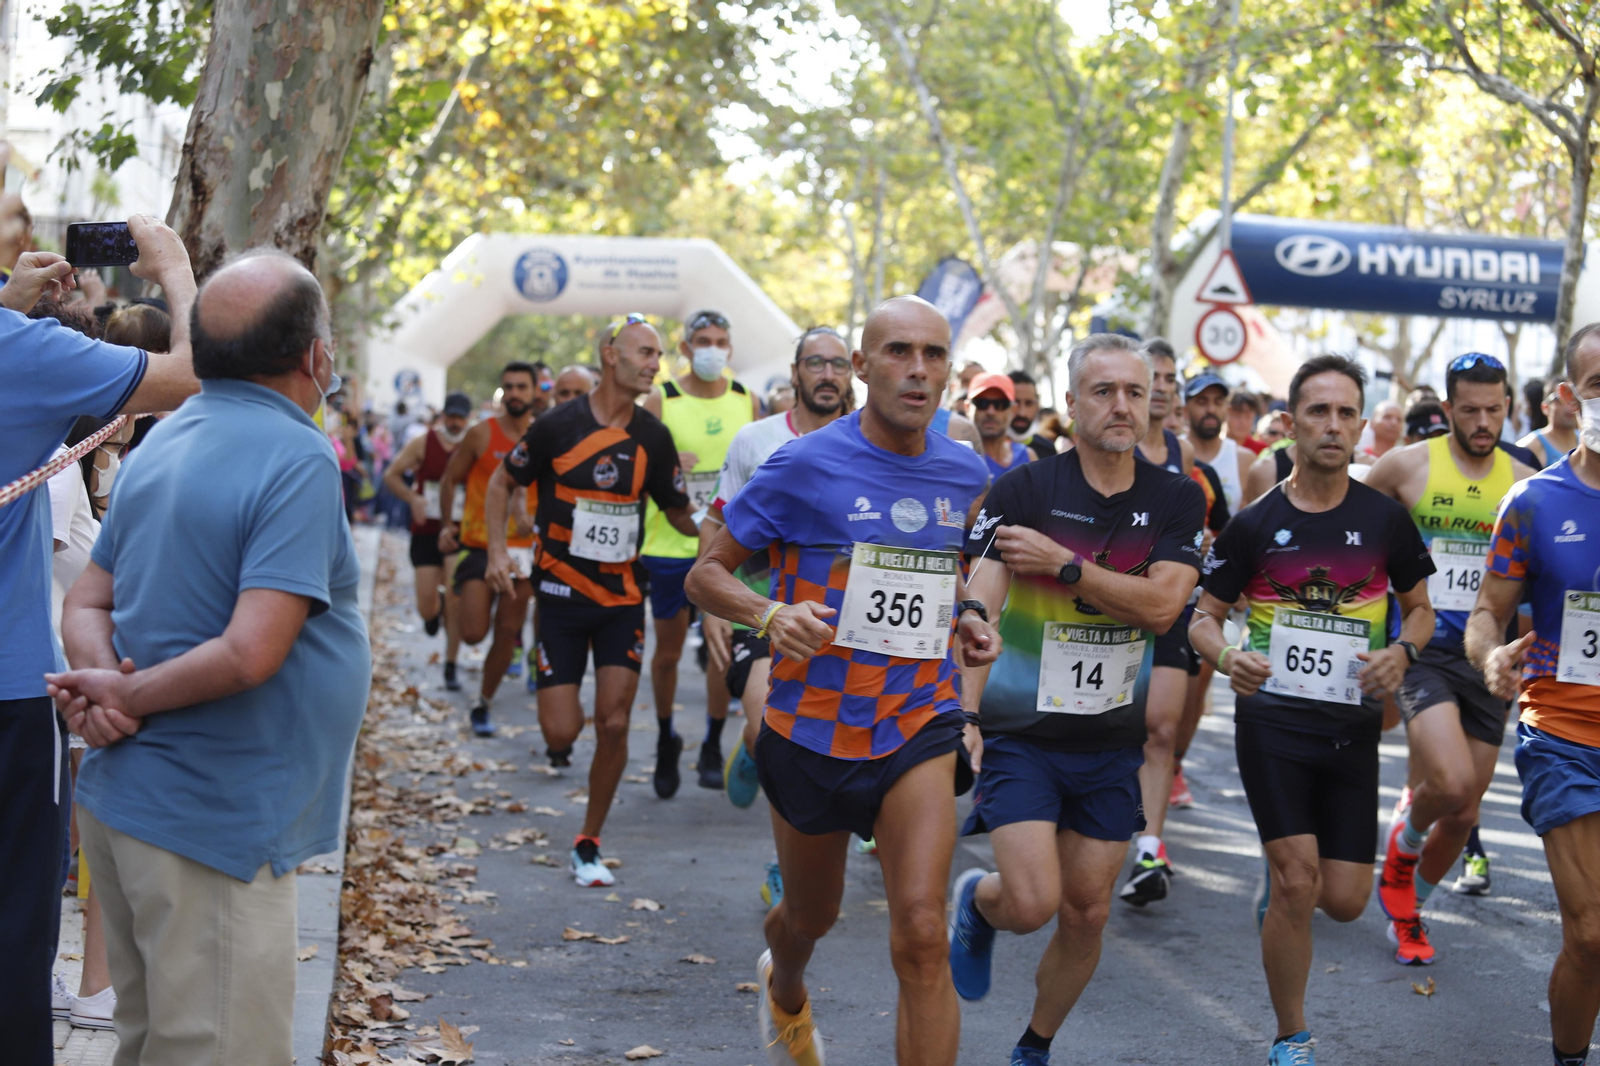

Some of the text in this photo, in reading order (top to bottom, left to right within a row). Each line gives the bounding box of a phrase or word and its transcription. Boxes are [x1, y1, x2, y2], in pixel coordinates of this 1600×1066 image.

[1357, 242, 1542, 285] HYUNDAI
[1438, 285, 1538, 315] SYRLUZ
[1208, 325, 1238, 346] 30
[585, 524, 620, 546] 453
[861, 550, 877, 564] 34
[879, 552, 915, 569] VUELTA
[916, 556, 924, 570] A
[1445, 568, 1481, 591] 148
[866, 589, 925, 629] 356
[1291, 614, 1324, 630] VUELTA
[1325, 619, 1333, 631] A
[1066, 627, 1100, 643] VUELTA
[1102, 631, 1110, 643] A
[1057, 643, 1115, 653] MANUEL JESUS
[1285, 645, 1334, 677] 655
[1071, 660, 1104, 690] 14
